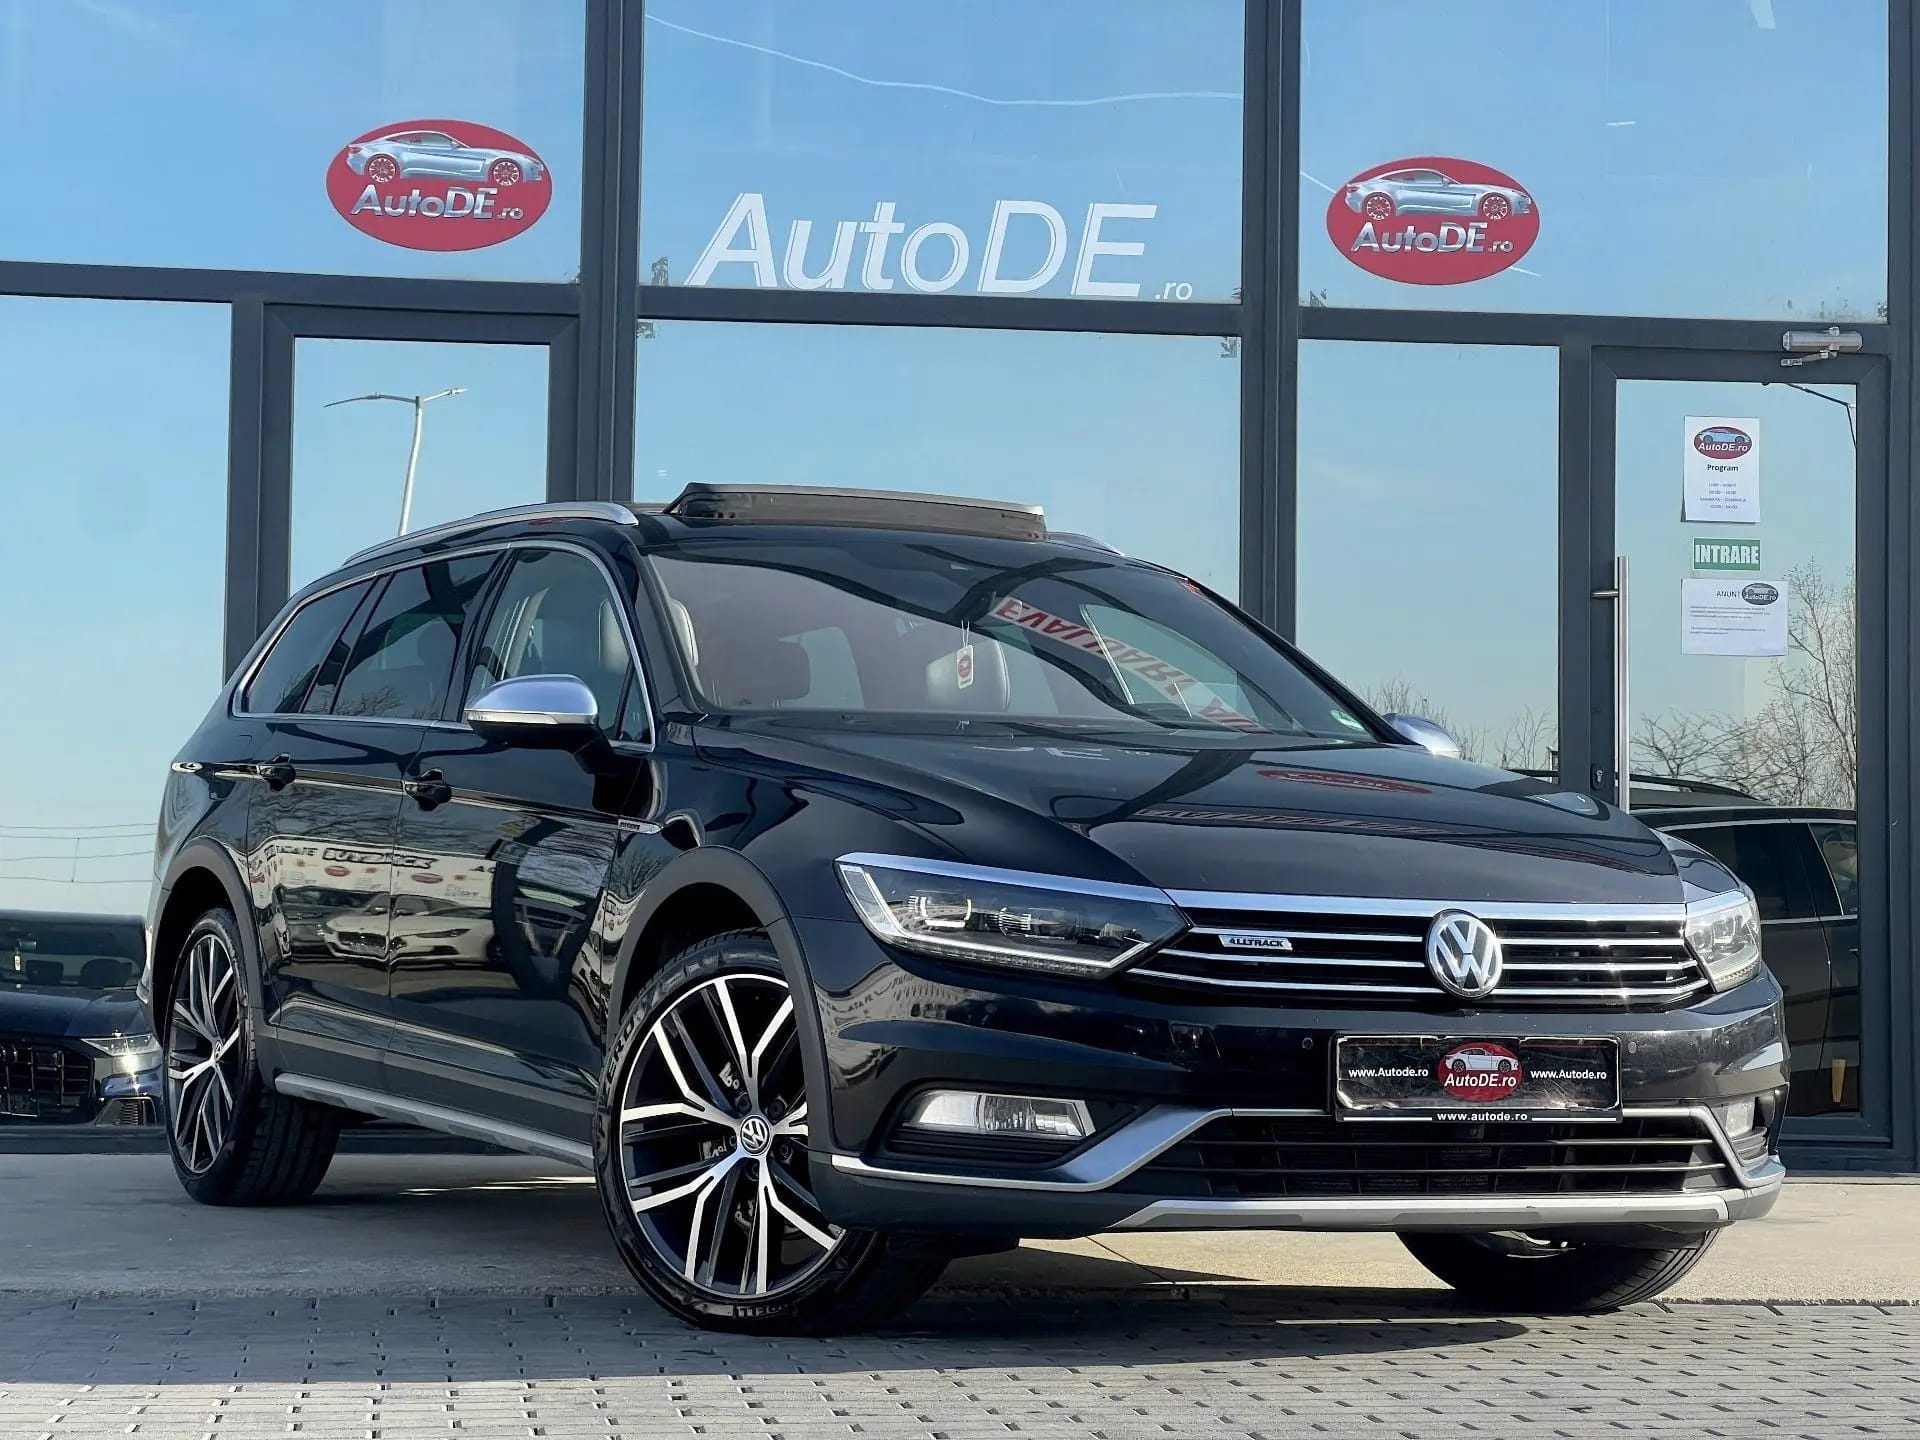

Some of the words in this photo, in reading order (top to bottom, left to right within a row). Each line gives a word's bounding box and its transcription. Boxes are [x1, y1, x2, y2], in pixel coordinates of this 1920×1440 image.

[1698, 443, 1748, 452] AutoDE.ro
[1707, 464, 1739, 472] Program
[1695, 544, 1759, 564] INTRARE
[1229, 938, 1284, 947] ALLTRACK
[1348, 1067, 1429, 1078] www.Autode.ro
[1444, 1073, 1517, 1088] AutoDE.ro
[1530, 1069, 1607, 1080] www.Autode.ro
[1437, 1112, 1528, 1121] www.autode.ro
